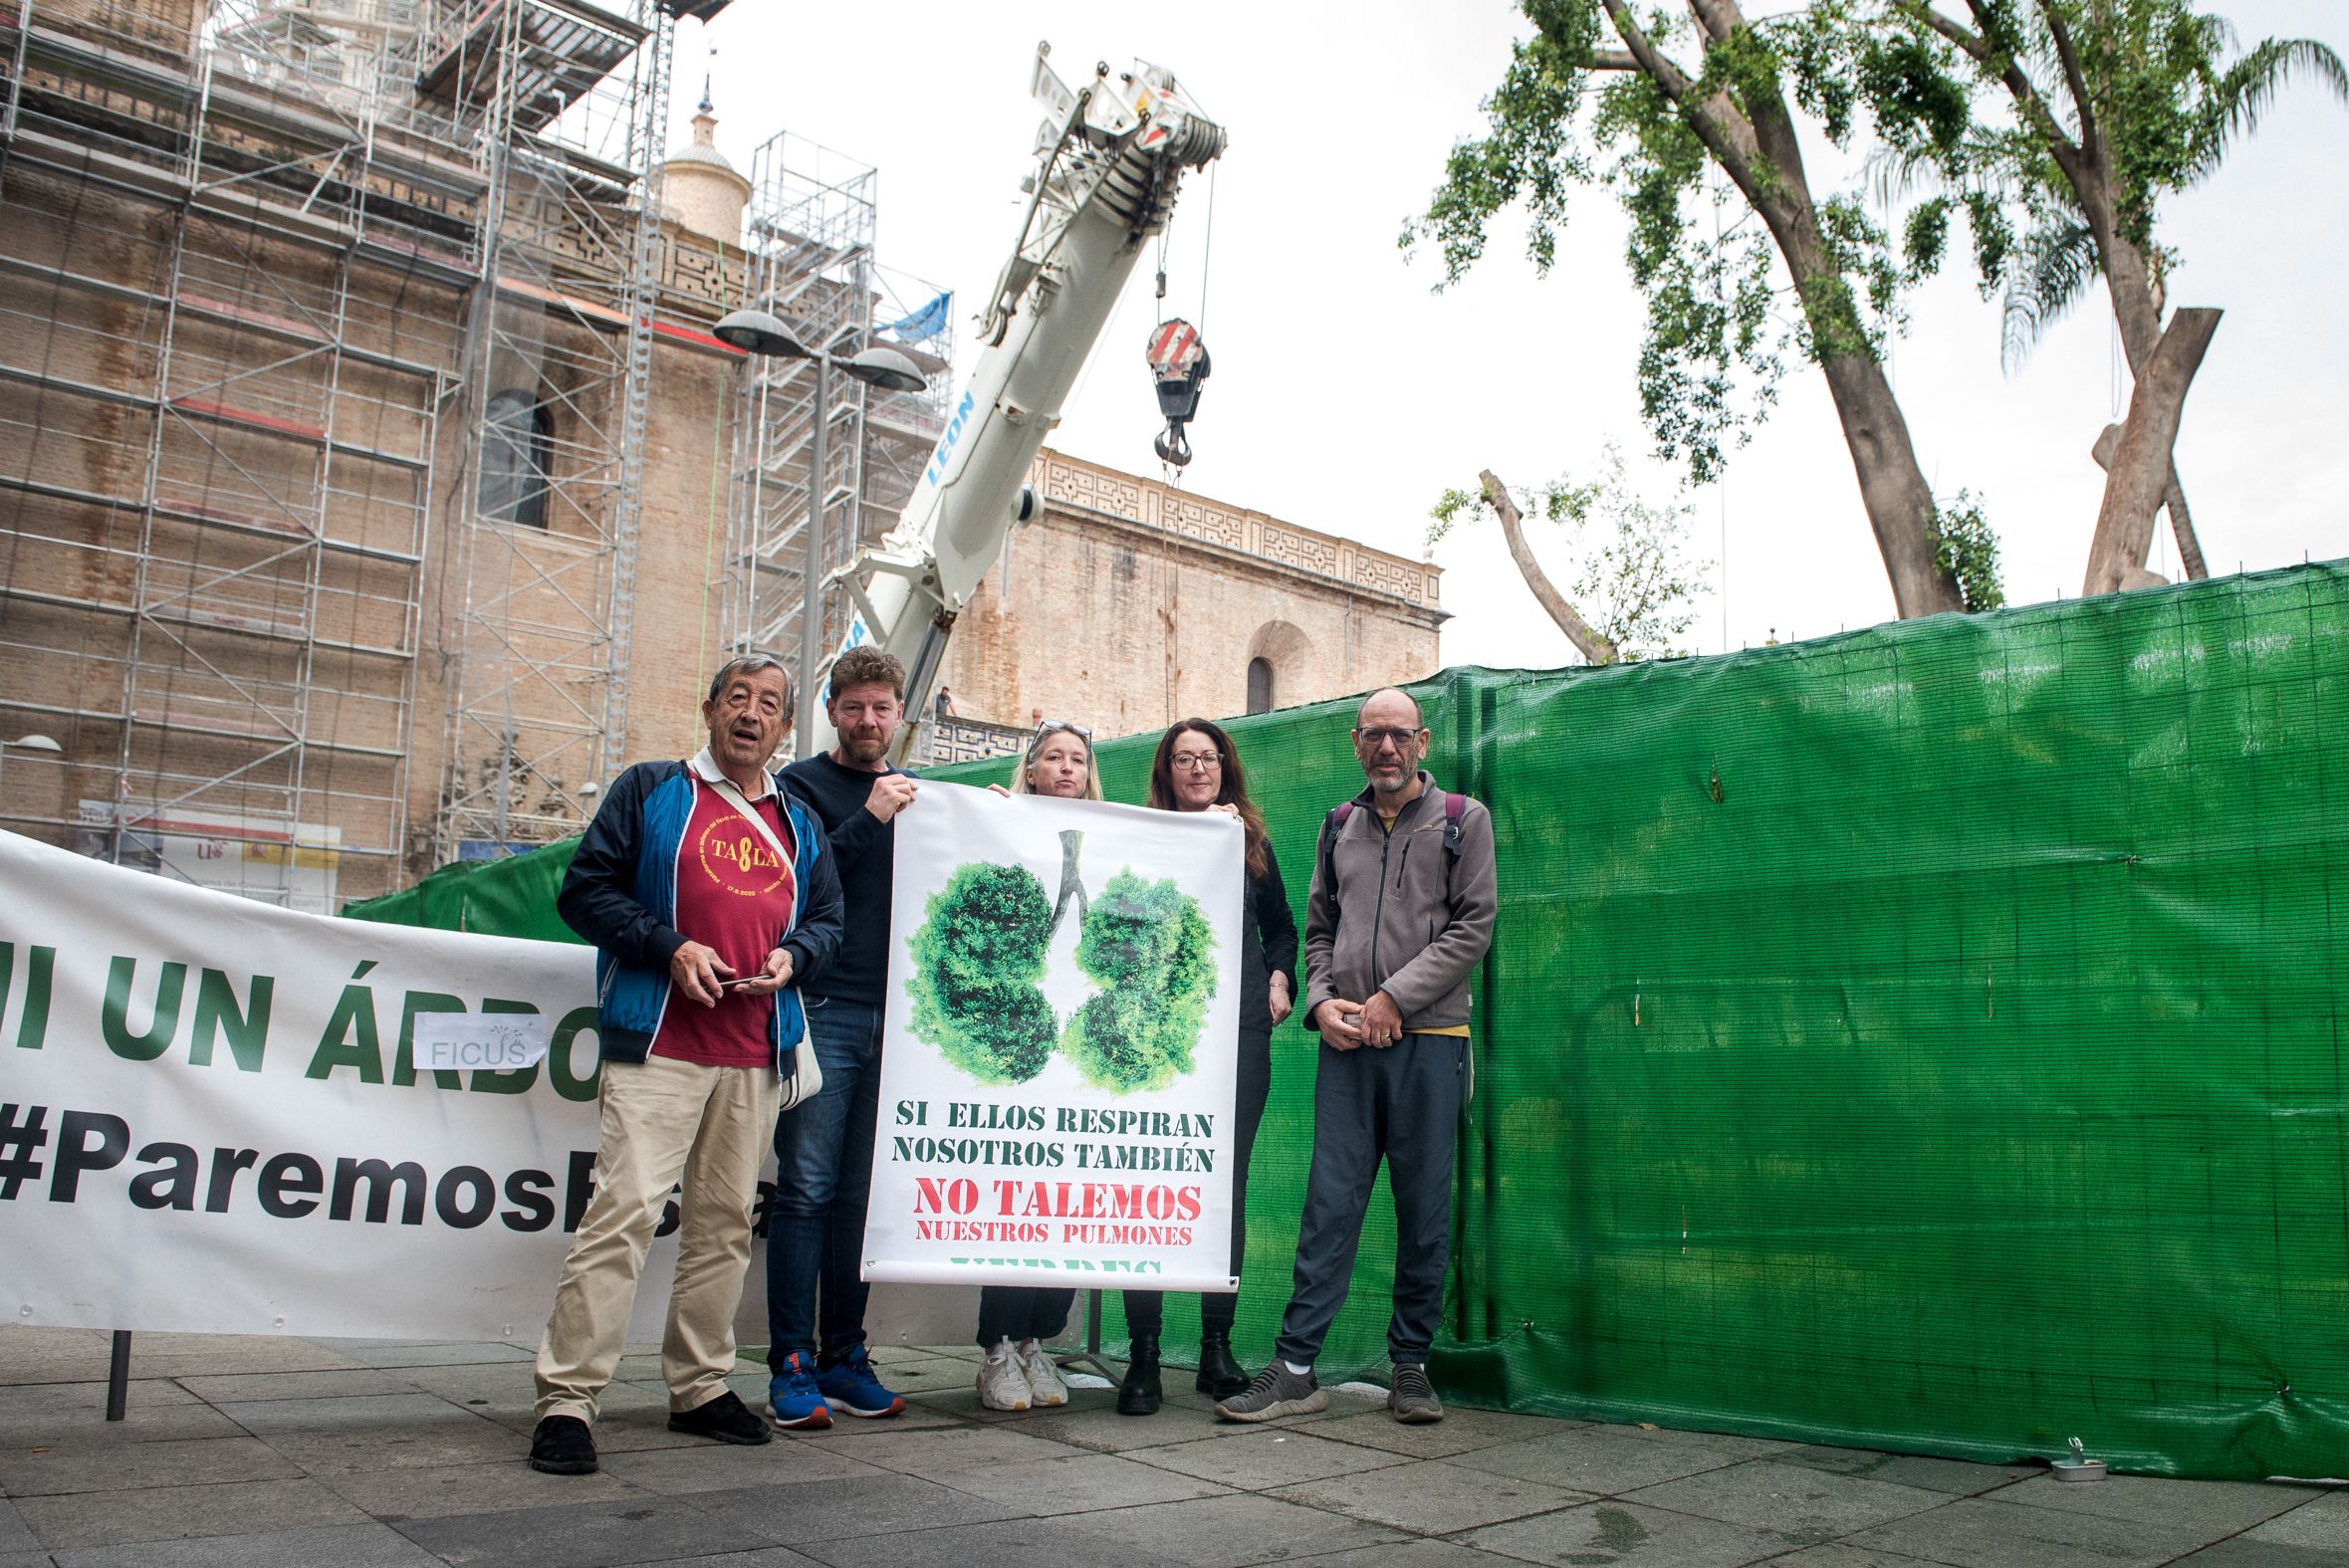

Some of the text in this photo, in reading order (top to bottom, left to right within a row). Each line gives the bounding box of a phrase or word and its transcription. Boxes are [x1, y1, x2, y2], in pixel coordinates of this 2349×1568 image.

[926, 391, 977, 488] LEON
[0, 940, 57, 1050] I
[101, 955, 275, 1073] UN
[431, 1041, 527, 1066] FICUS
[895, 1099, 1215, 1138] SI ELLOS RESPIRAN
[891, 1136, 1216, 1173] NOSOTROS TAMBIÉN
[912, 1177, 1202, 1222] NO TALEMOS
[915, 1220, 1193, 1245] NUESTROS PULMONES
